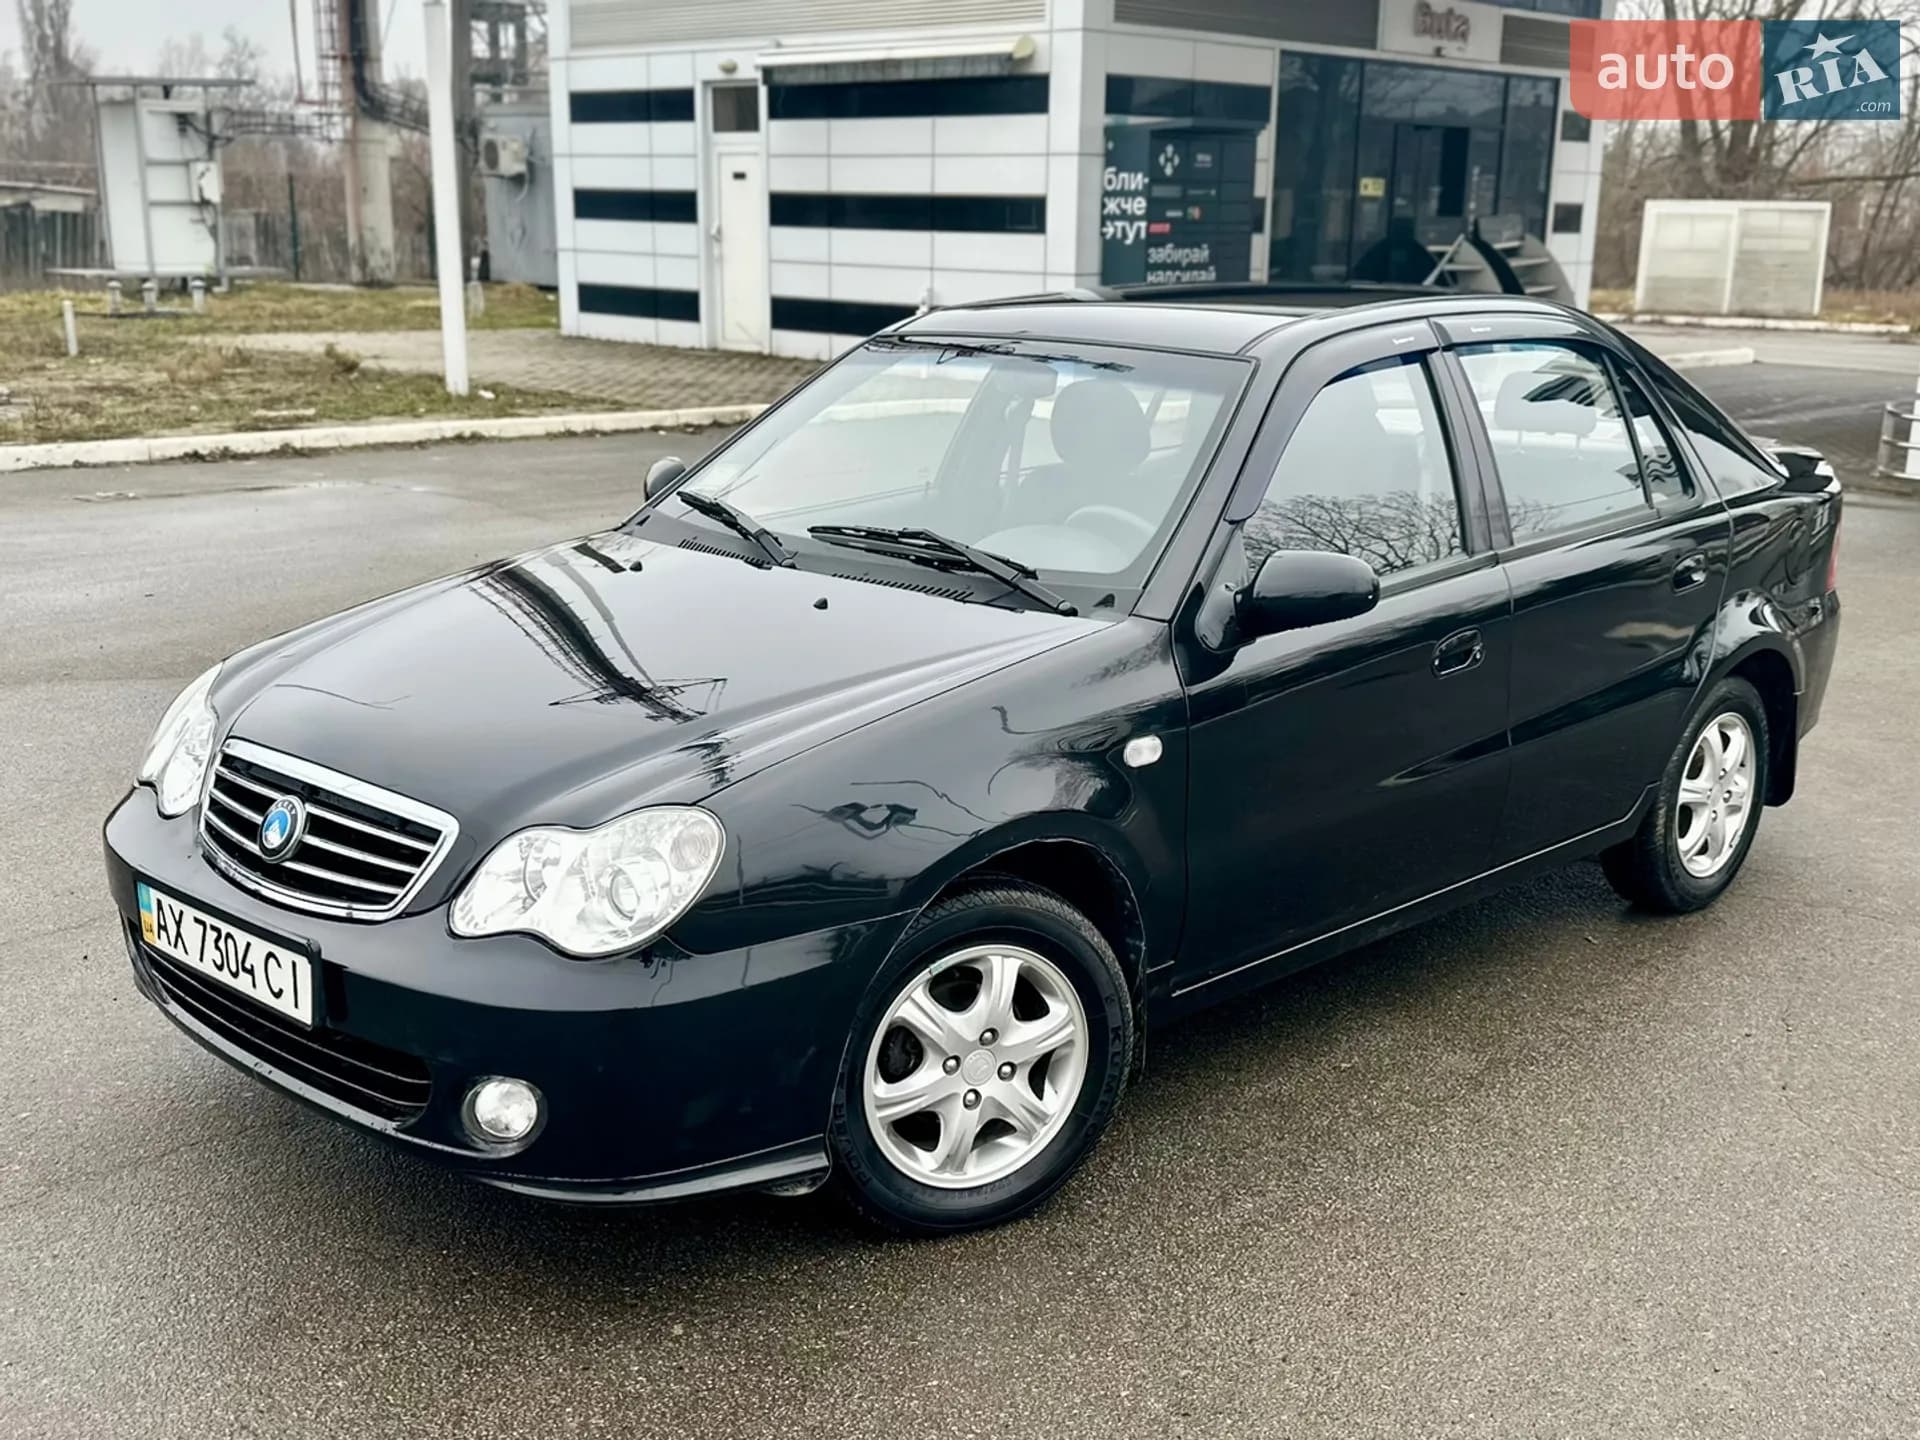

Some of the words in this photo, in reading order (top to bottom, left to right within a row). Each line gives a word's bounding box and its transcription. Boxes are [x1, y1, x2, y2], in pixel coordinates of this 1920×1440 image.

[1103, 196, 1147, 215] жче
[1148, 243, 1209, 267] забирай
[157, 898, 189, 956] AX
[193, 916, 257, 989] 7304
